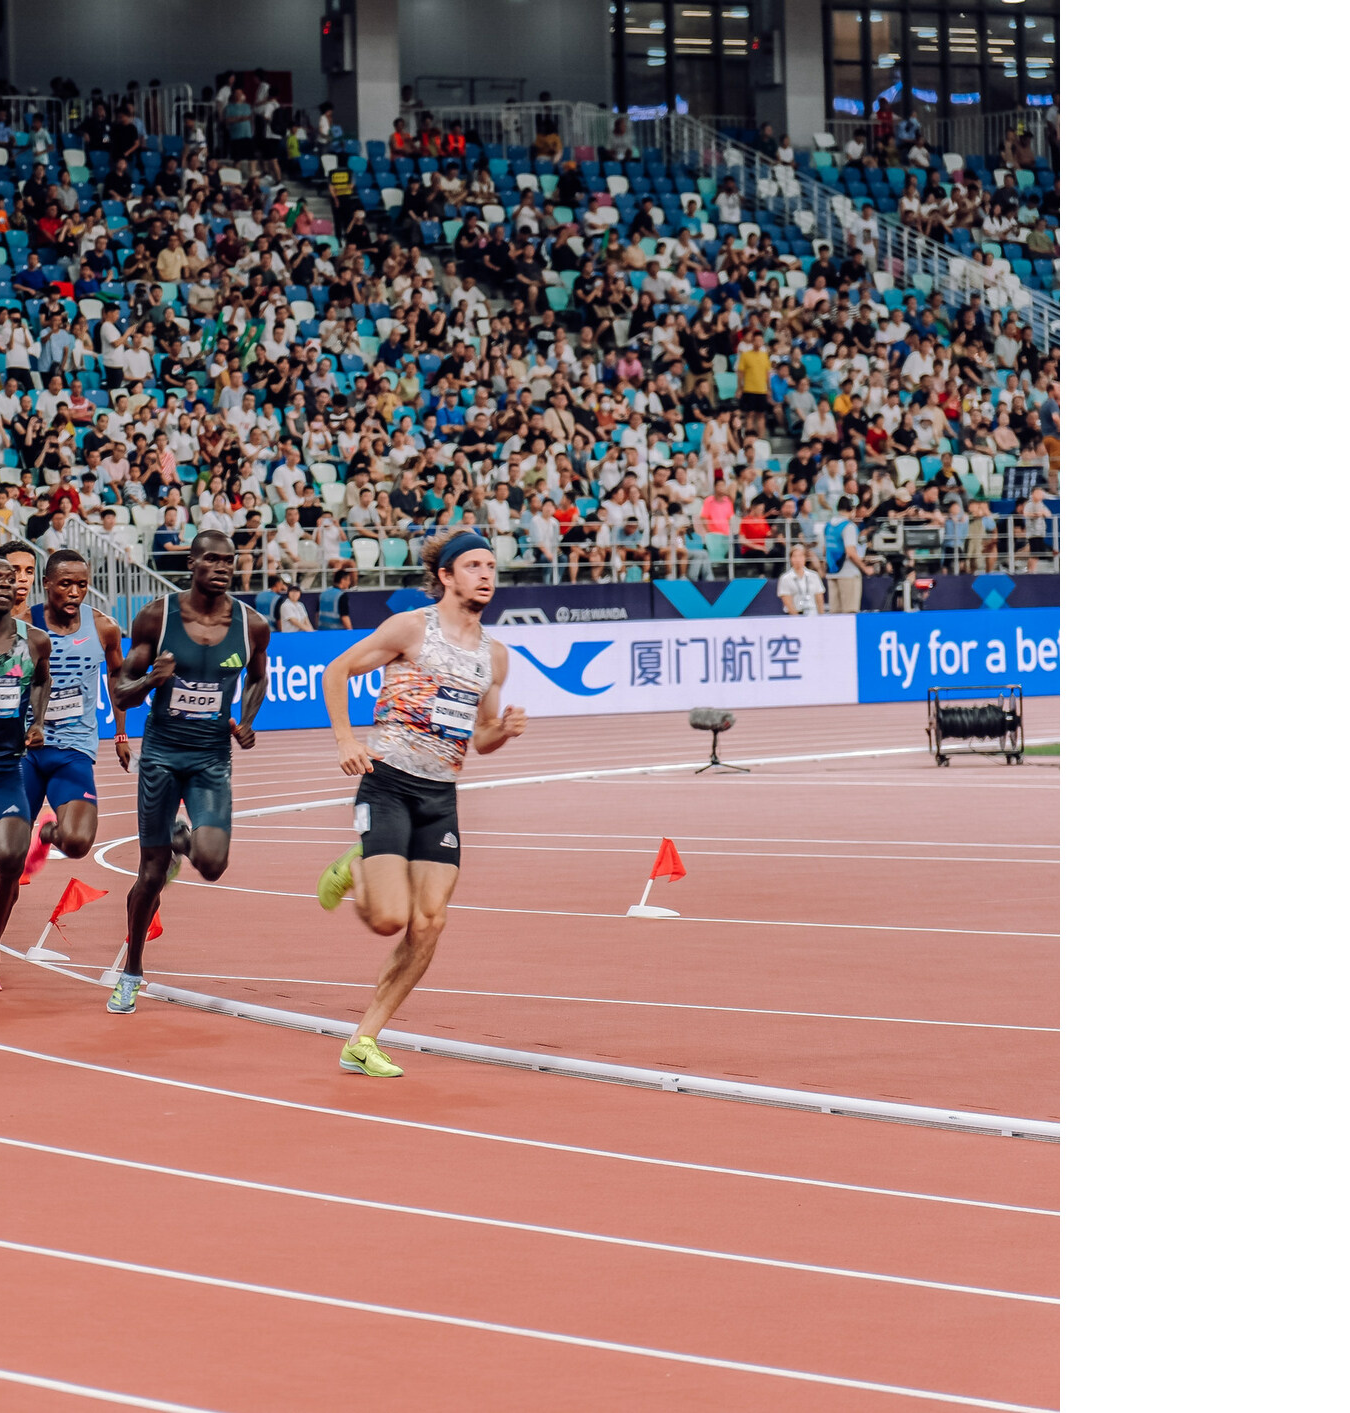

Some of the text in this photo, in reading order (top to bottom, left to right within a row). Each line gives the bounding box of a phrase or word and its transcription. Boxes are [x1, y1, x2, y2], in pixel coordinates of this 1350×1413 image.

[591, 607, 628, 620] WANDA
[630, 635, 802, 687] 厦门航空
[879, 626, 1060, 689] fly for a be
[178, 695, 216, 706] AROP
